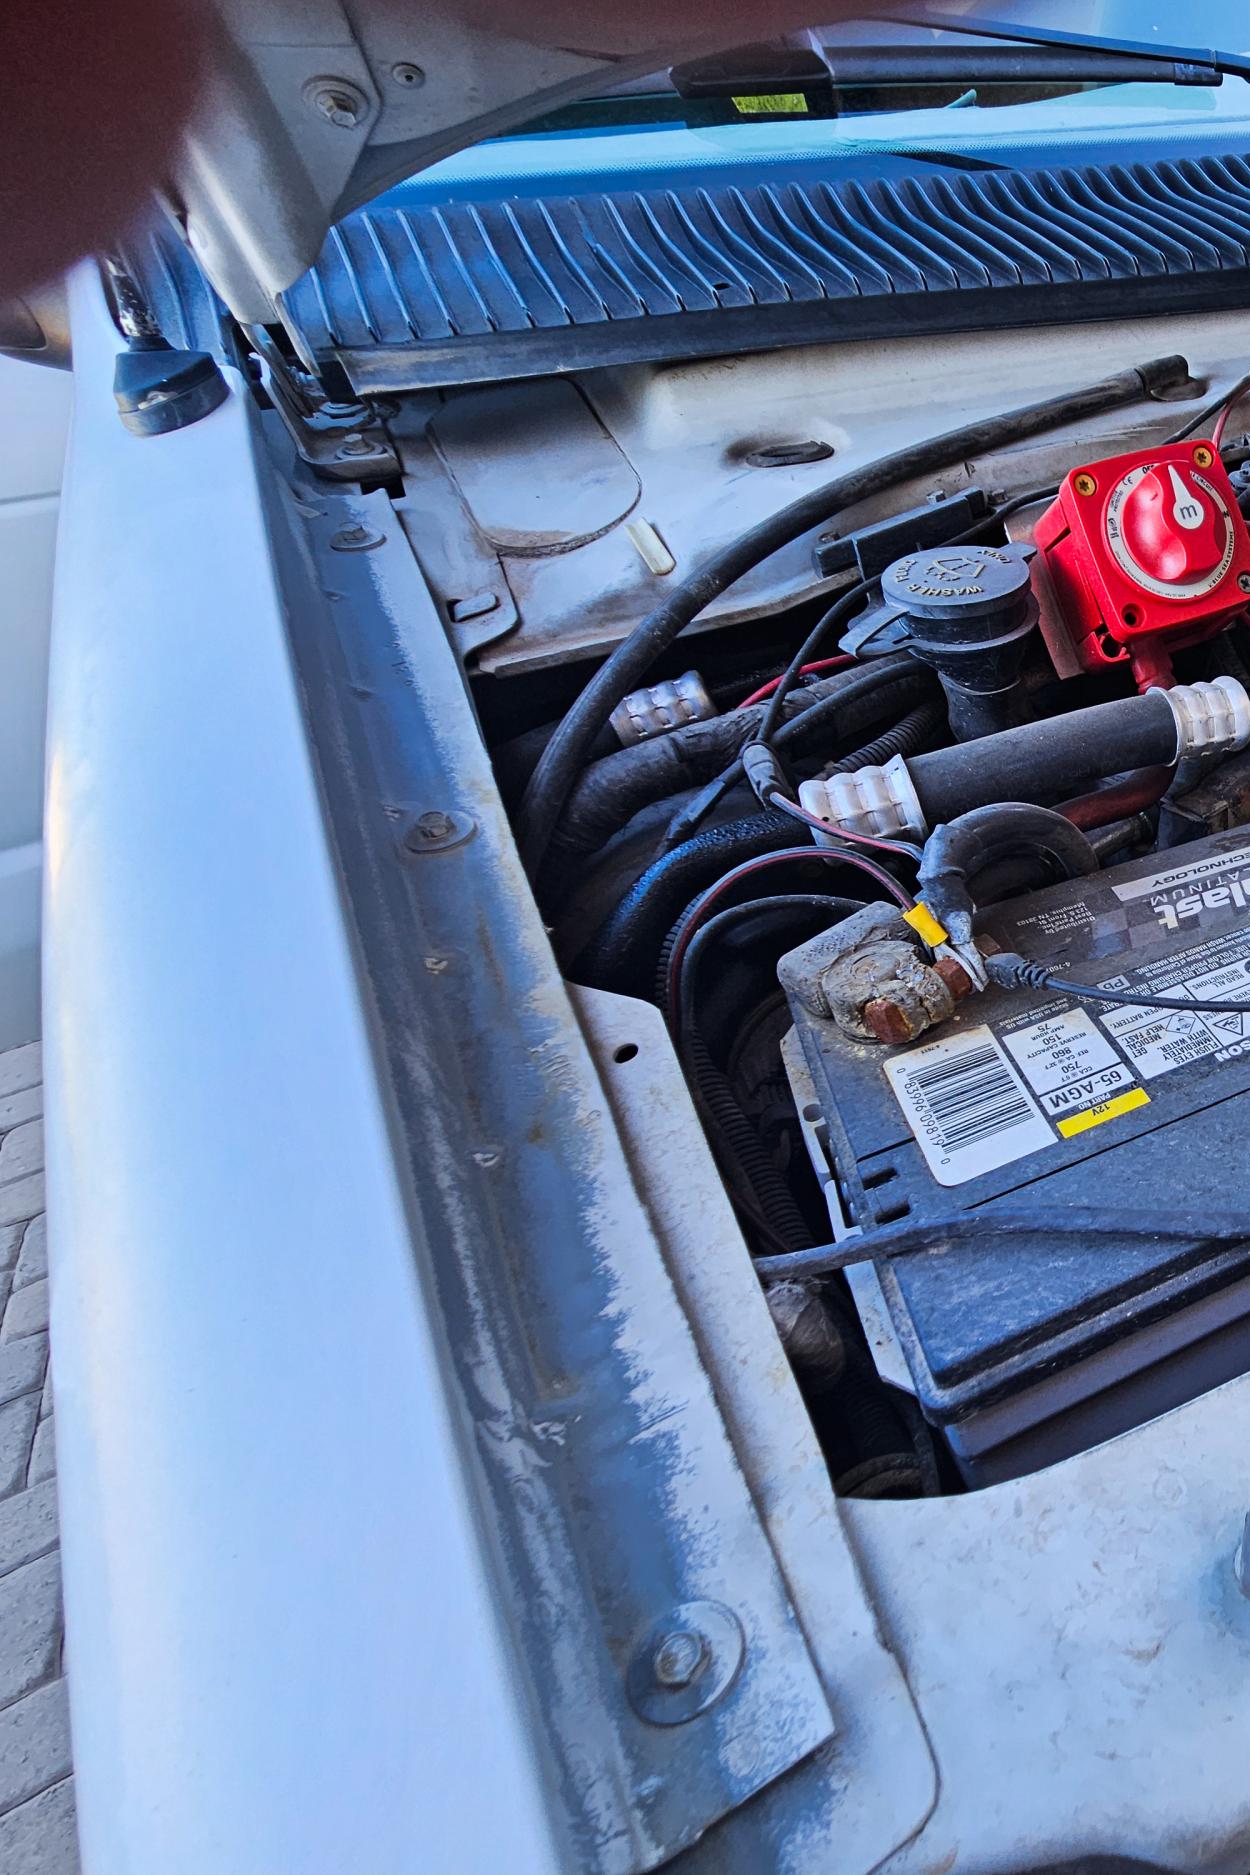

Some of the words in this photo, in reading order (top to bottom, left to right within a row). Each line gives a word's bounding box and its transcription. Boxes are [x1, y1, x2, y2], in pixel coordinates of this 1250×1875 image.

[1180, 504, 1198, 519] m
[895, 560, 917, 582] FLUID
[907, 583, 984, 597] WASHER
[1205, 936, 1226, 948] WASH
[1166, 951, 1186, 962] AFTER
[1206, 950, 1232, 963] FOLLOW
[1180, 959, 1207, 973] PROPER
[1193, 965, 1209, 975] NOT
[1147, 969, 1181, 986] CHARGING
[1149, 970, 1194, 992] DISASSEMBLE
[1212, 979, 1225, 987] ALL
[1225, 972, 1244, 982] READ
[1102, 978, 1124, 991] Pb
[1139, 988, 1150, 996] OR
[1109, 1012, 1143, 1029] BATTERY.
[1036, 1023, 1050, 1032] 75
[1049, 1024, 1065, 1033] AMP
[1142, 1023, 1164, 1035] HELP
[1030, 1030, 1049, 1040] HOUR
[1041, 1033, 1061, 1045] 150
[1058, 1031, 1086, 1045] RESERVE
[1121, 1031, 1144, 1044] FAST.
[1125, 1032, 1161, 1050] MEDICAL
[1186, 1028, 1207, 1041] WITH
[1025, 1042, 1058, 1059] CAPACITY
[1156, 1037, 1187, 1053] WATER.
[1161, 1035, 1213, 1060] IMMEDIATELY
[1193, 1041, 1219, 1055] FLUSH
[1050, 1046, 1071, 1059] 860
[1130, 1046, 1148, 1058] GET
[1172, 1051, 1194, 1064] EYES
[1060, 1060, 1082, 1073] 750
[1047, 1069, 1123, 1108] 65-AGM
[1089, 1092, 1111, 1104] PART
[1075, 1100, 1091, 1111] NO.
[1089, 1103, 1110, 1115] 12V
